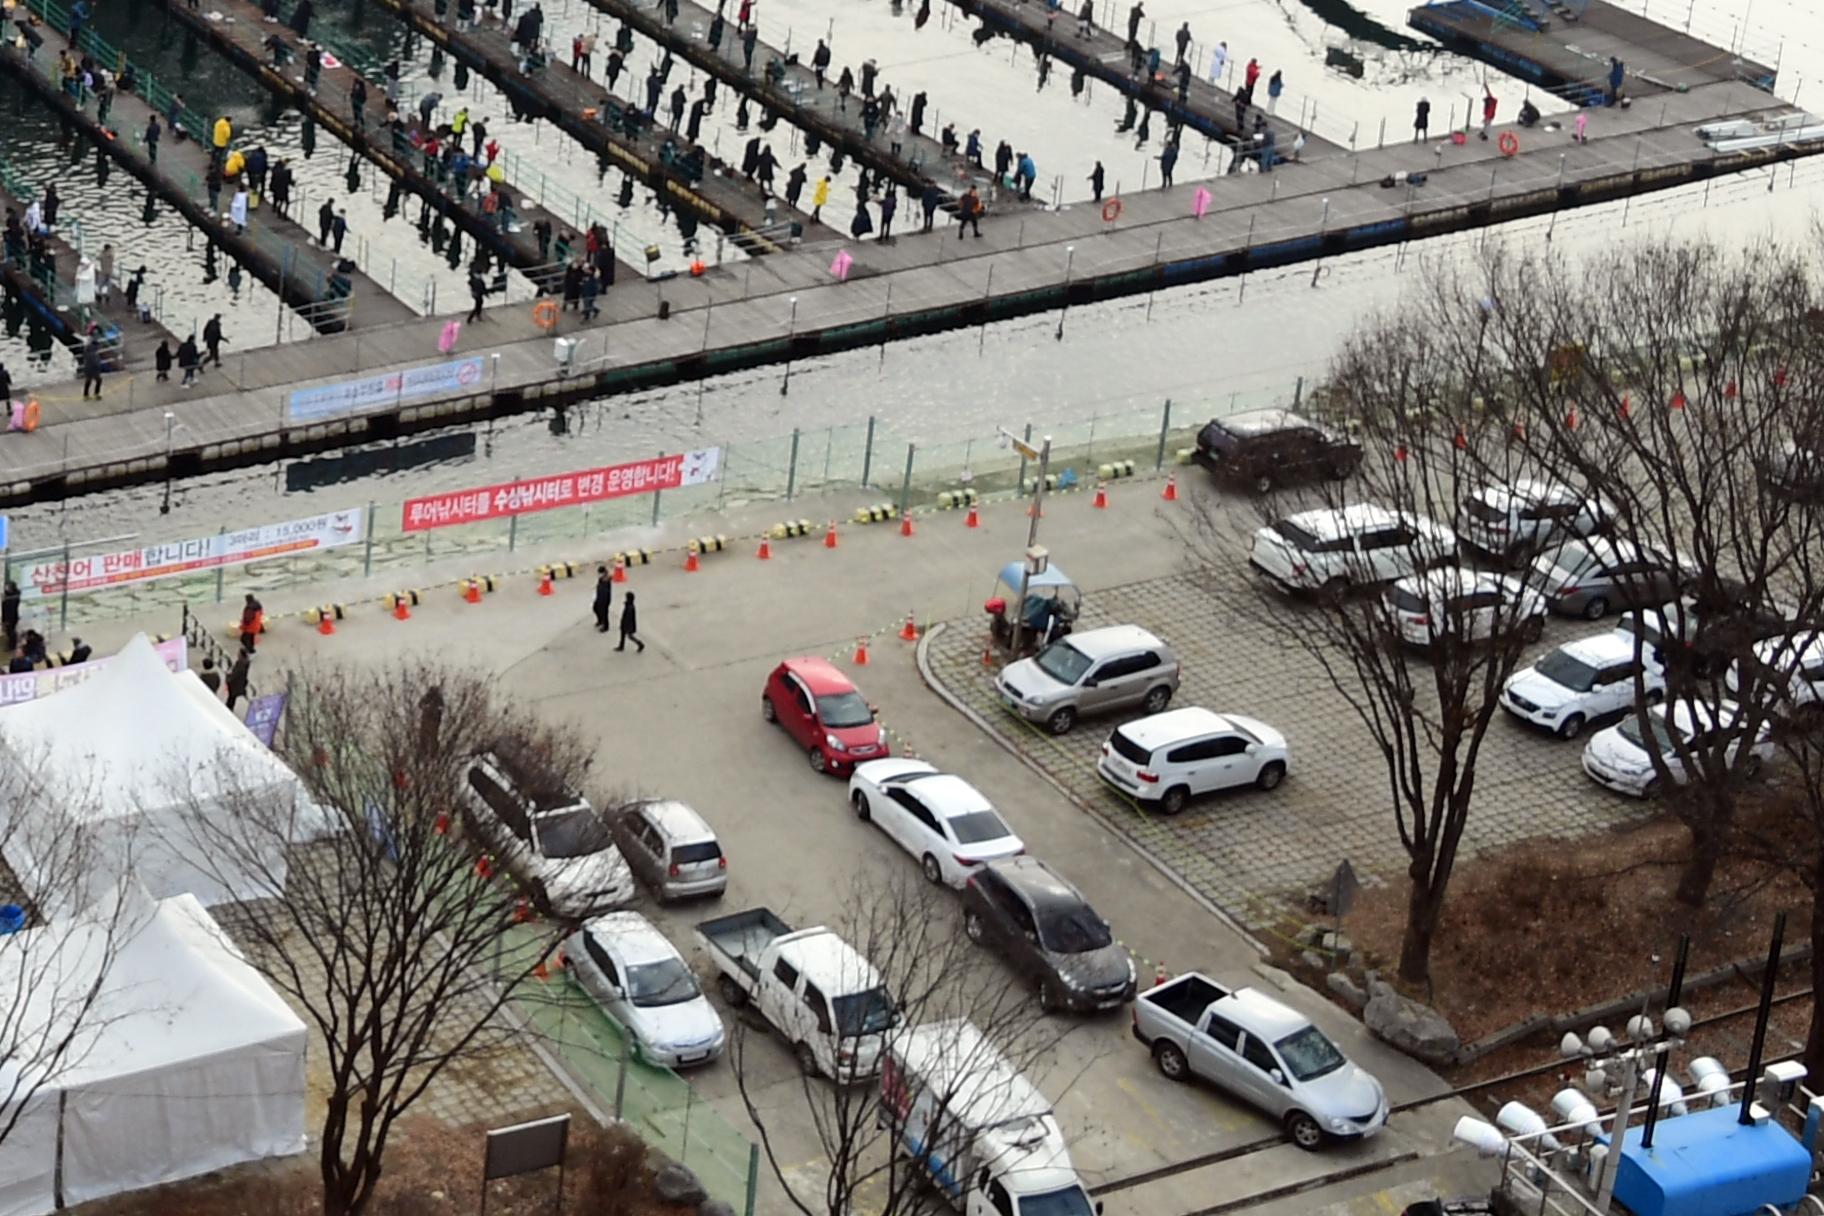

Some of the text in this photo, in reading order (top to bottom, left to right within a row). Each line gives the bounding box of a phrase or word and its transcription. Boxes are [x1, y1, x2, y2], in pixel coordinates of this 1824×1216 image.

[410, 461, 677, 526] 루어낚시터를 수상낚시터로 변경 운영합니다!
[102, 537, 211, 574] 판매합니다!
